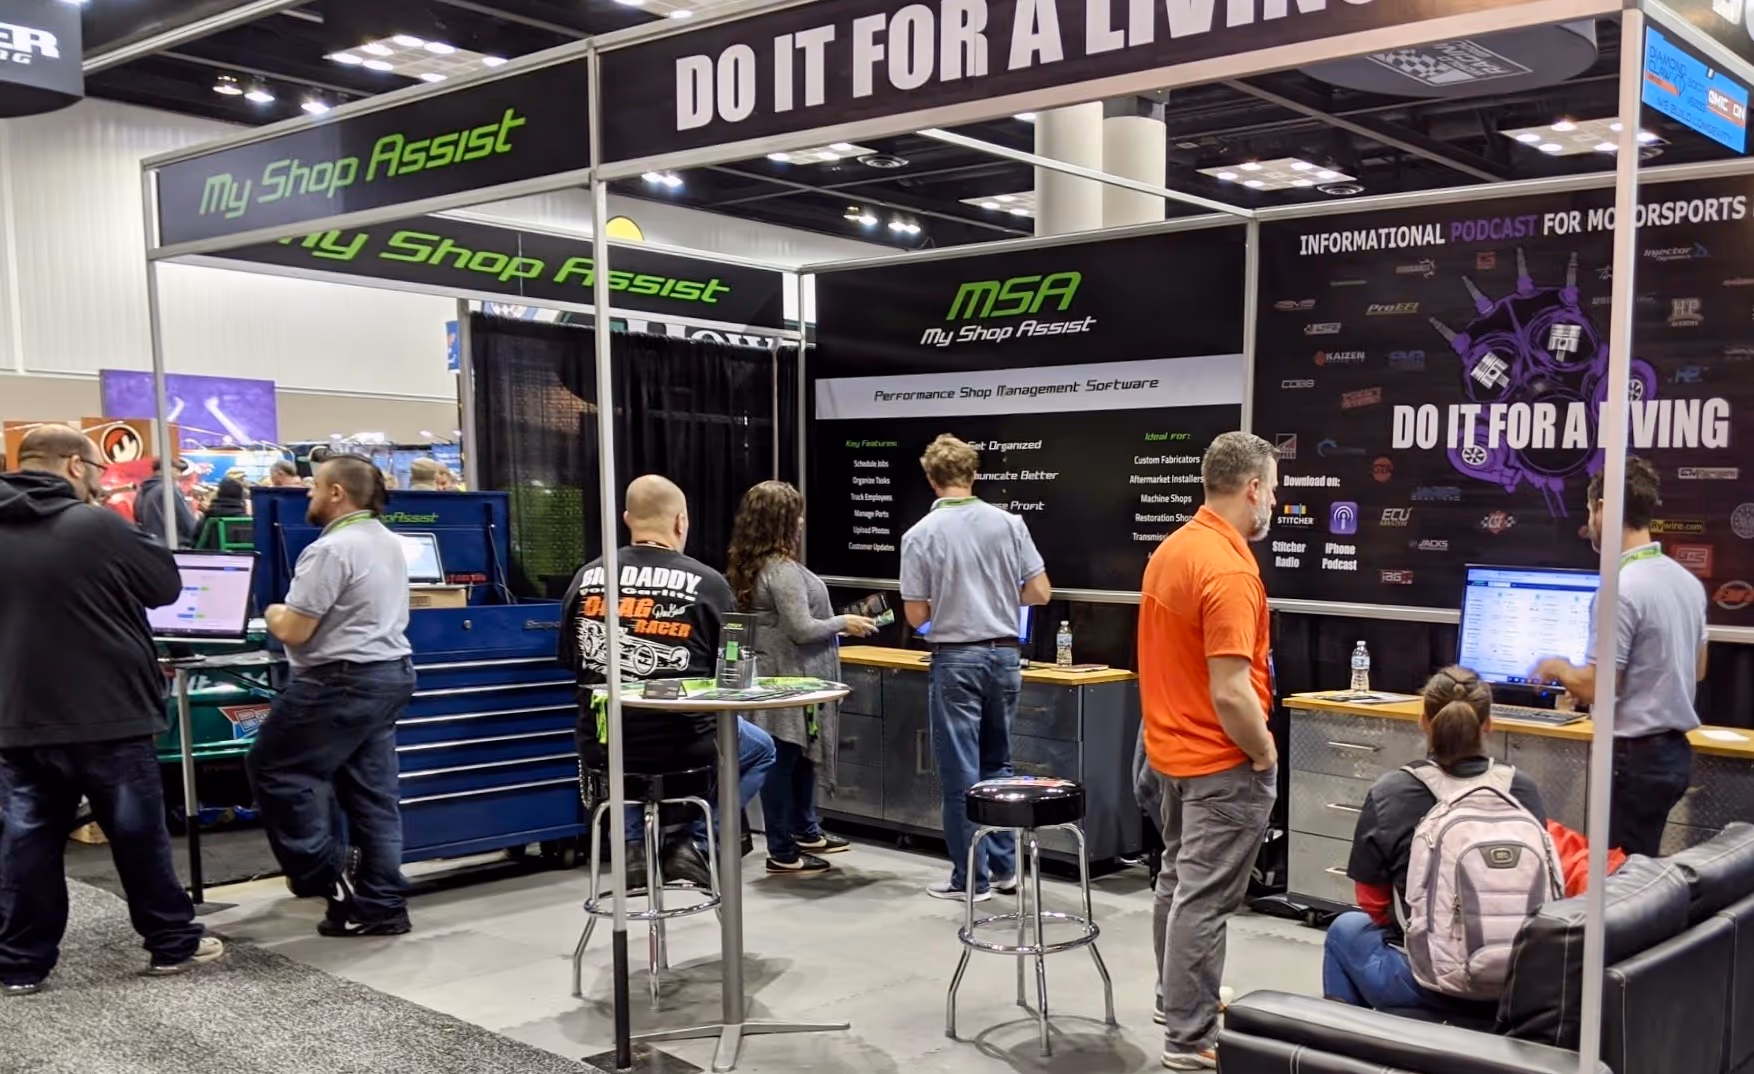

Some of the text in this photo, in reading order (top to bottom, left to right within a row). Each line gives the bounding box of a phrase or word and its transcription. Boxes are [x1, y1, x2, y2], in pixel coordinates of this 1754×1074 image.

[676, 43, 755, 131] DO
[774, 24, 835, 112] IT
[853, 0, 988, 98] FOR
[1008, 0, 1064, 70] A
[199, 107, 527, 219] My Shop Assist
[1299, 196, 1747, 256] INFORMATIONAL PODCAST FOR MOORSPORTS
[379, 230, 545, 282] Shop
[553, 256, 731, 304] Assist
[946, 271, 1082, 321] MSA
[920, 316, 1097, 347] My Shop Assist
[1326, 351, 1366, 361] KAIZEN
[874, 377, 1160, 403] Performance Shop Management Software
[1392, 397, 1730, 450] DO IT FOR A VING
[1144, 432, 1168, 441] Ideal
[845, 440, 860, 449] Key
[988, 440, 1042, 453] Organized
[853, 460, 889, 468] Schedule Jobs
[1133, 455, 1200, 465] Custom Fabricators
[852, 476, 891, 486] Organize Tasks
[1020, 469, 1059, 481] Better
[1129, 474, 1204, 484] Aftermarket Installers
[1283, 475, 1341, 488] Download on:
[864, 493, 893, 503] Employees
[1140, 494, 1192, 505] Machine Shops
[1010, 500, 1045, 511] Profit
[854, 509, 889, 519] Manage Parts
[1135, 513, 1194, 522] Restoration Shop
[1381, 507, 1412, 521] ECU
[1277, 516, 1314, 525] STITCHER
[853, 526, 890, 535] Upload Photos
[848, 542, 895, 552] Customer Updates
[1272, 540, 1307, 554] Stitcher
[1275, 556, 1300, 569] Radio
[1322, 558, 1358, 571] Podcast
[583, 595, 655, 619] DAG
[634, 620, 692, 638] RACER
